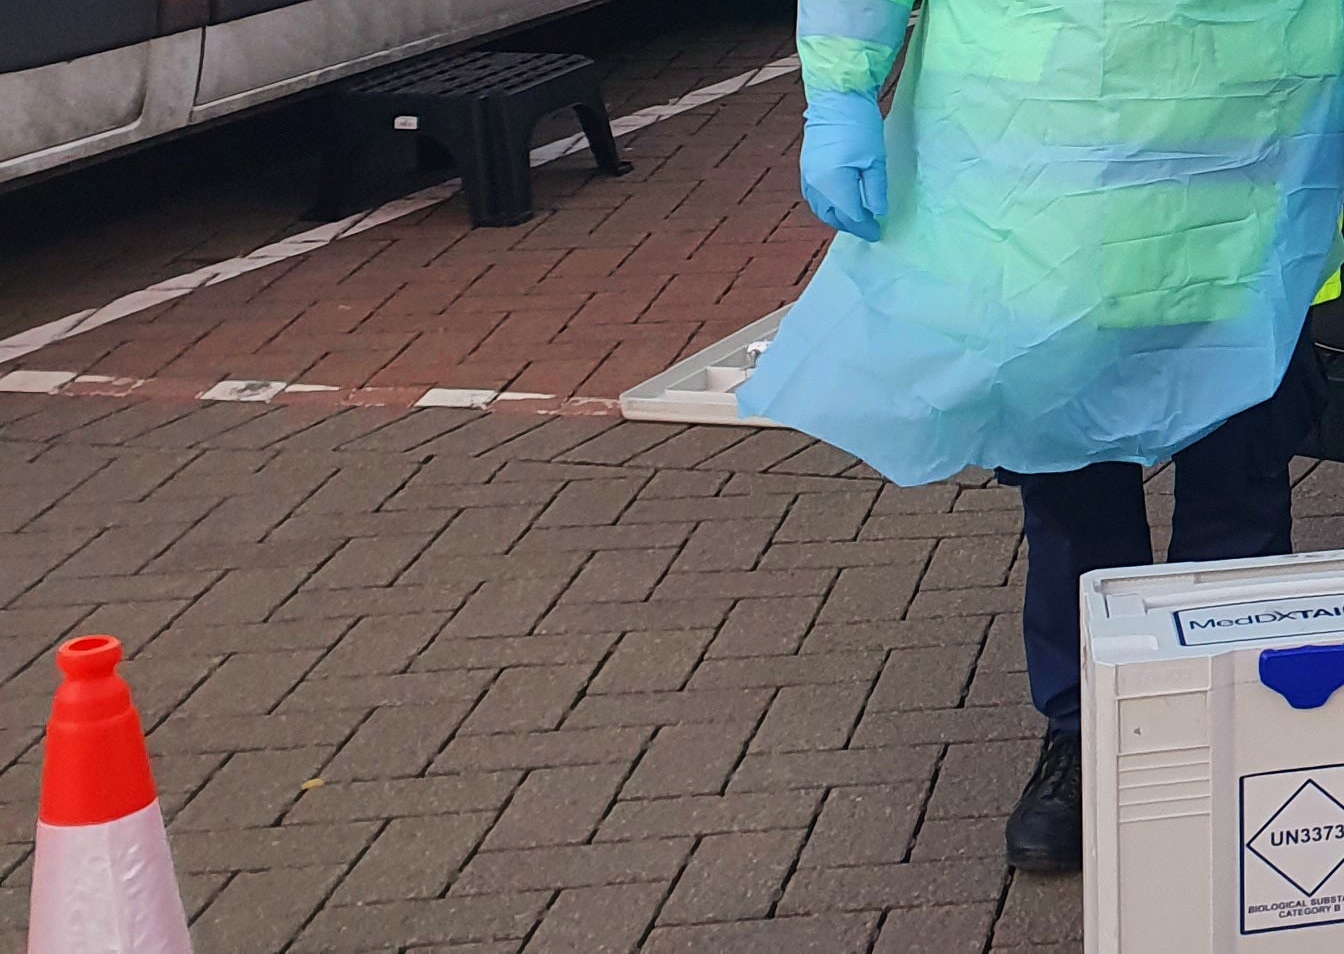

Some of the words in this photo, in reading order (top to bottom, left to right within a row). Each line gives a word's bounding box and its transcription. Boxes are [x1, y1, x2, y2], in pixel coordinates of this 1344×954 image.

[1271, 824, 1344, 846] UN3373
[1248, 900, 1306, 914] BIOLOGICAL
[1278, 906, 1331, 918] CATEGORY
[1334, 904, 1341, 912] B
